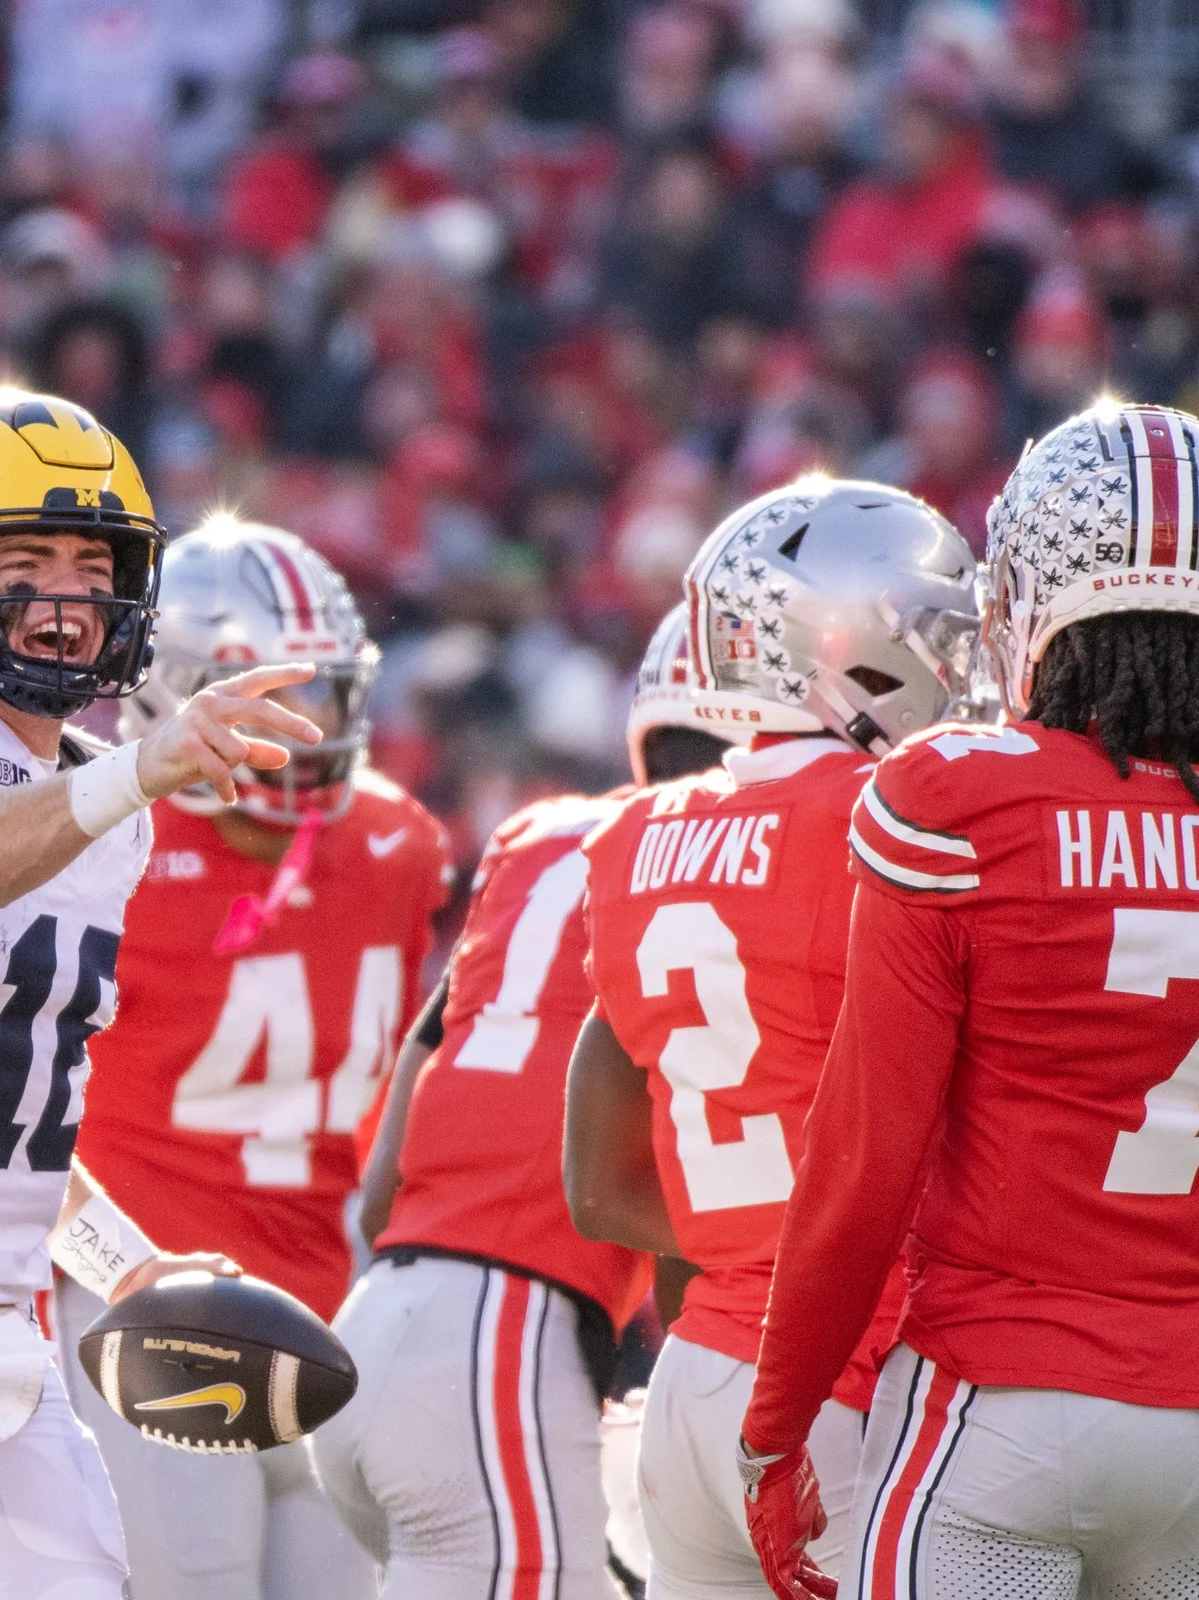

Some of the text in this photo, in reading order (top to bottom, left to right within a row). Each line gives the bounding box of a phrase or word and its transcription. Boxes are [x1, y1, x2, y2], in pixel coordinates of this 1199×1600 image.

[75, 488, 101, 507] M
[1093, 573, 1199, 592] BUCKEY
[1135, 761, 1181, 779] BUC
[629, 813, 779, 894] DOWNS
[171, 944, 401, 1187] 44
[635, 901, 797, 1213] 2
[1104, 907, 1199, 1196] 7
[69, 1217, 126, 1273] JAKE
